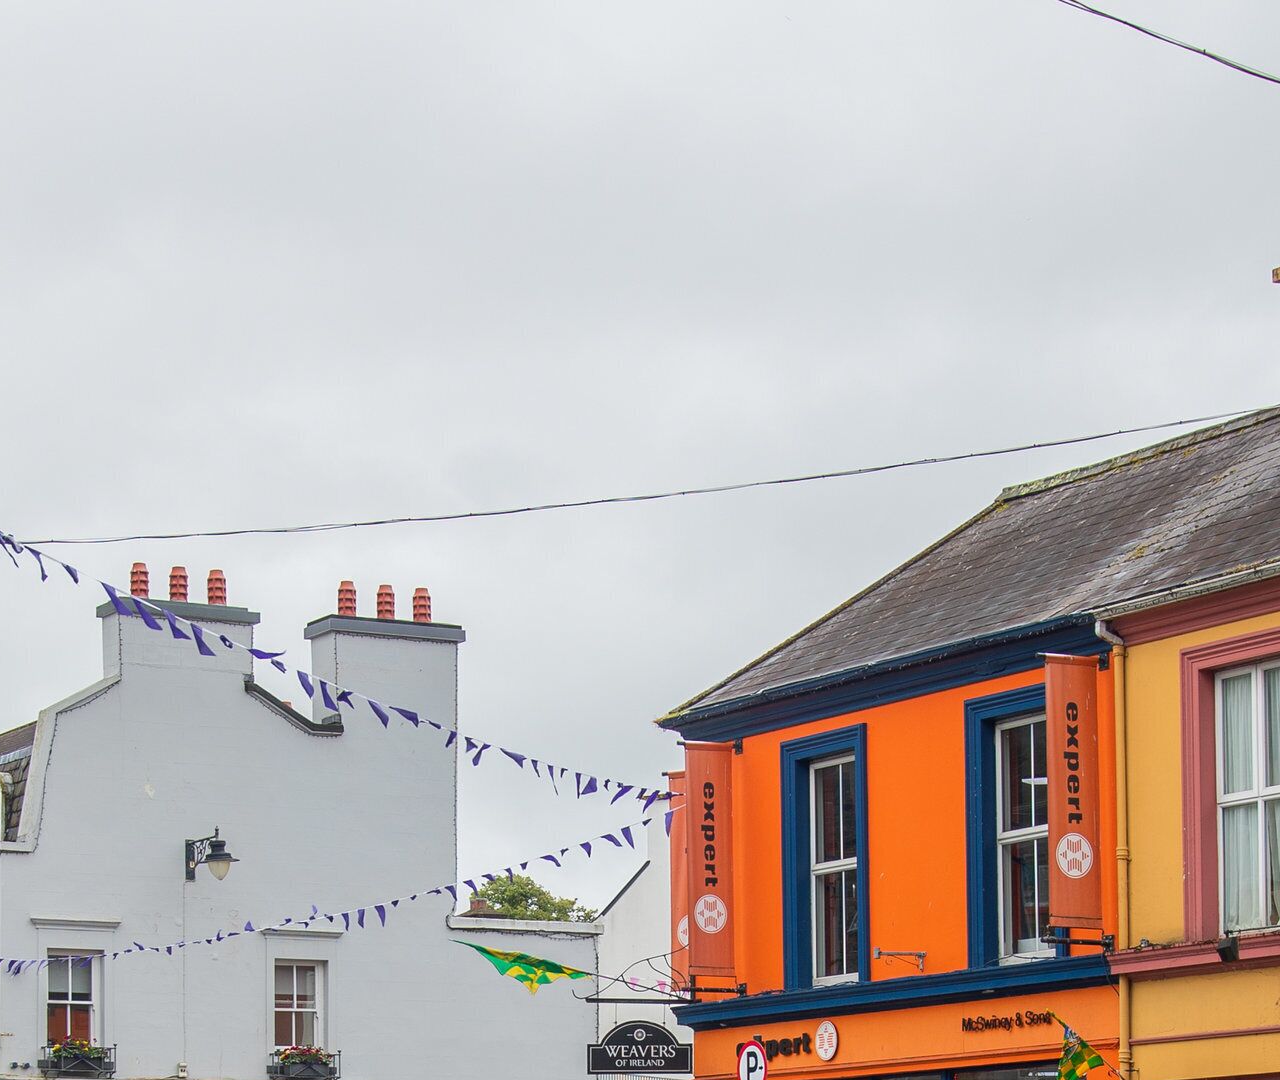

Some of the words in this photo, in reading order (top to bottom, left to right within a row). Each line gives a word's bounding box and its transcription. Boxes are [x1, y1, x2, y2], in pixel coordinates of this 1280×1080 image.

[1063, 702, 1083, 825] expert
[701, 782, 718, 887] expert
[1015, 1012, 1024, 1028] &
[604, 1044, 676, 1058] WEAVERS
[615, 1059, 628, 1067] OF
[630, 1059, 665, 1067] IRELAND
